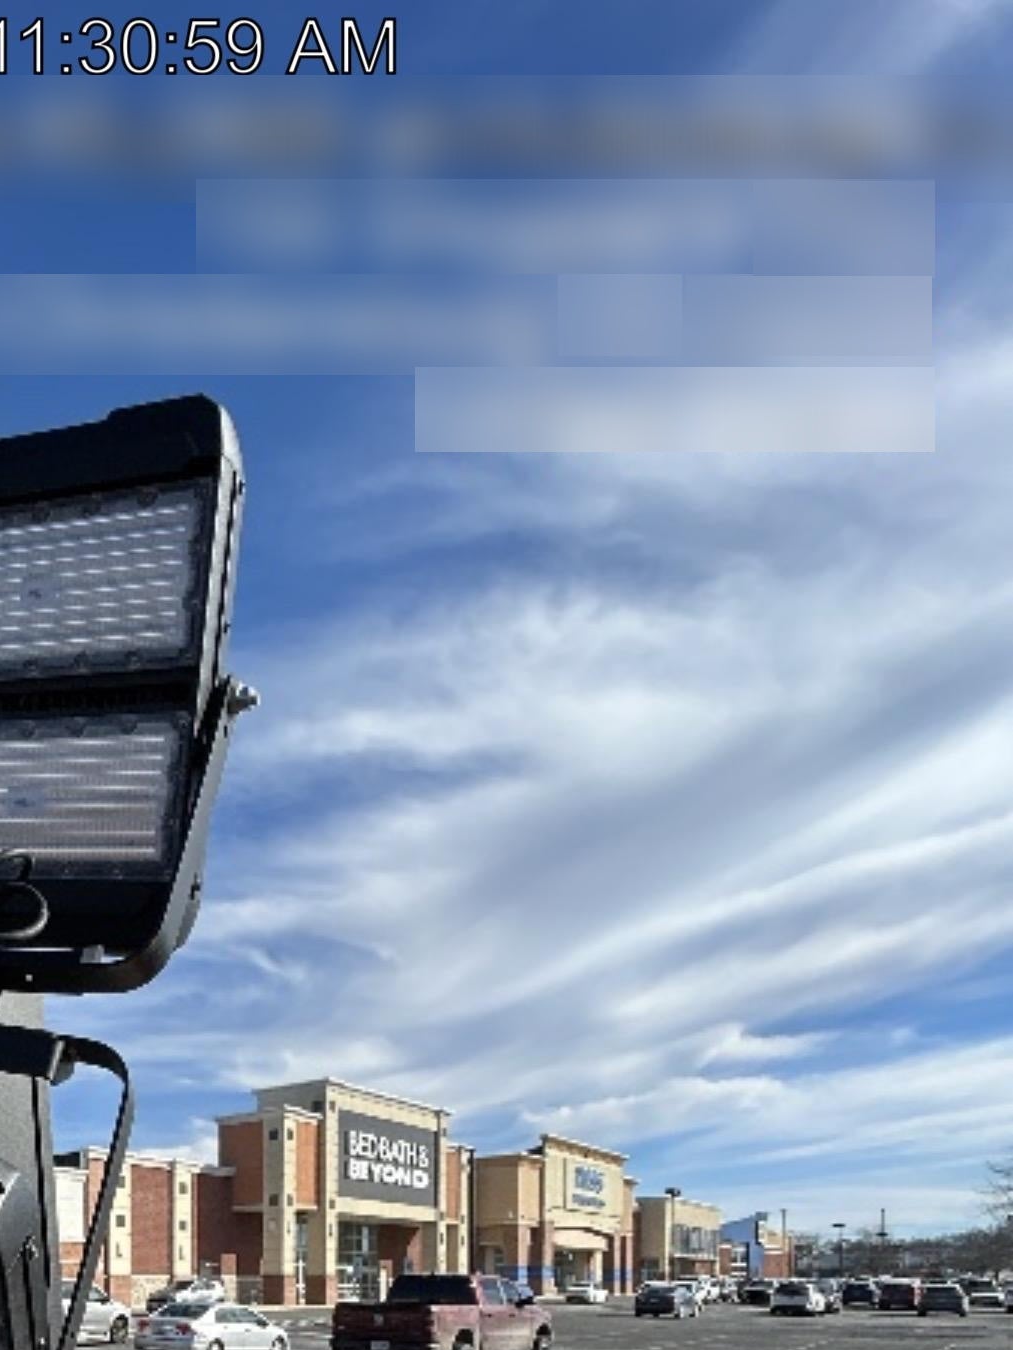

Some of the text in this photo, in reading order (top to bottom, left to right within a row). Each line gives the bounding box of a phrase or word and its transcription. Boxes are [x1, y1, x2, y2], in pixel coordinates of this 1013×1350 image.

[349, 1130, 429, 1168] BED BATH &
[349, 1158, 429, 1189] BEYOND
